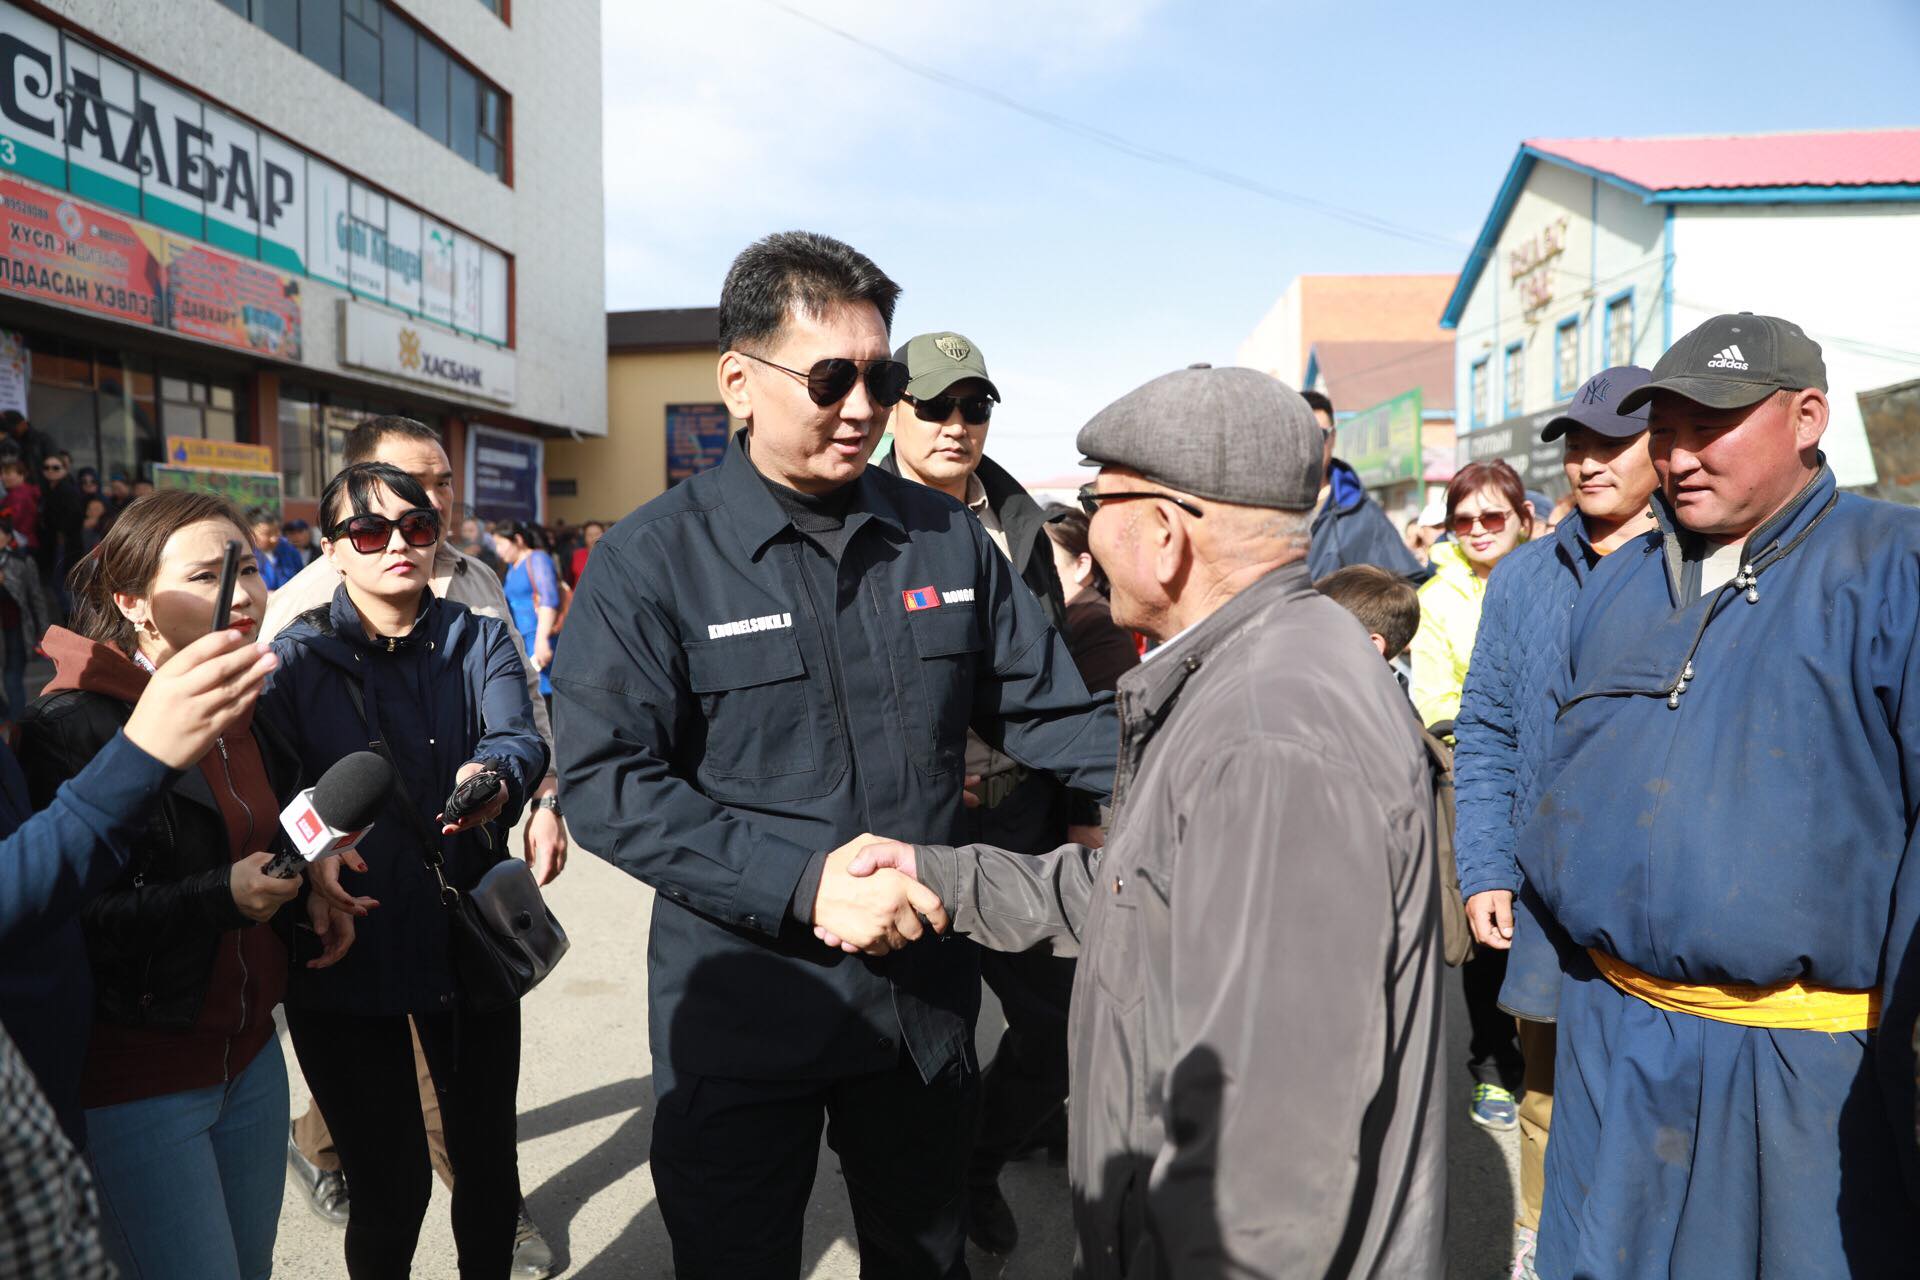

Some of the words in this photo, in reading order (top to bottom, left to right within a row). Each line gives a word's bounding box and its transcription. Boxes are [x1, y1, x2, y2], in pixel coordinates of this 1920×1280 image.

[0, 33, 294, 229] САЛБАР
[422, 352, 482, 387] ХАСБАНК
[1707, 357, 1749, 371] adidas
